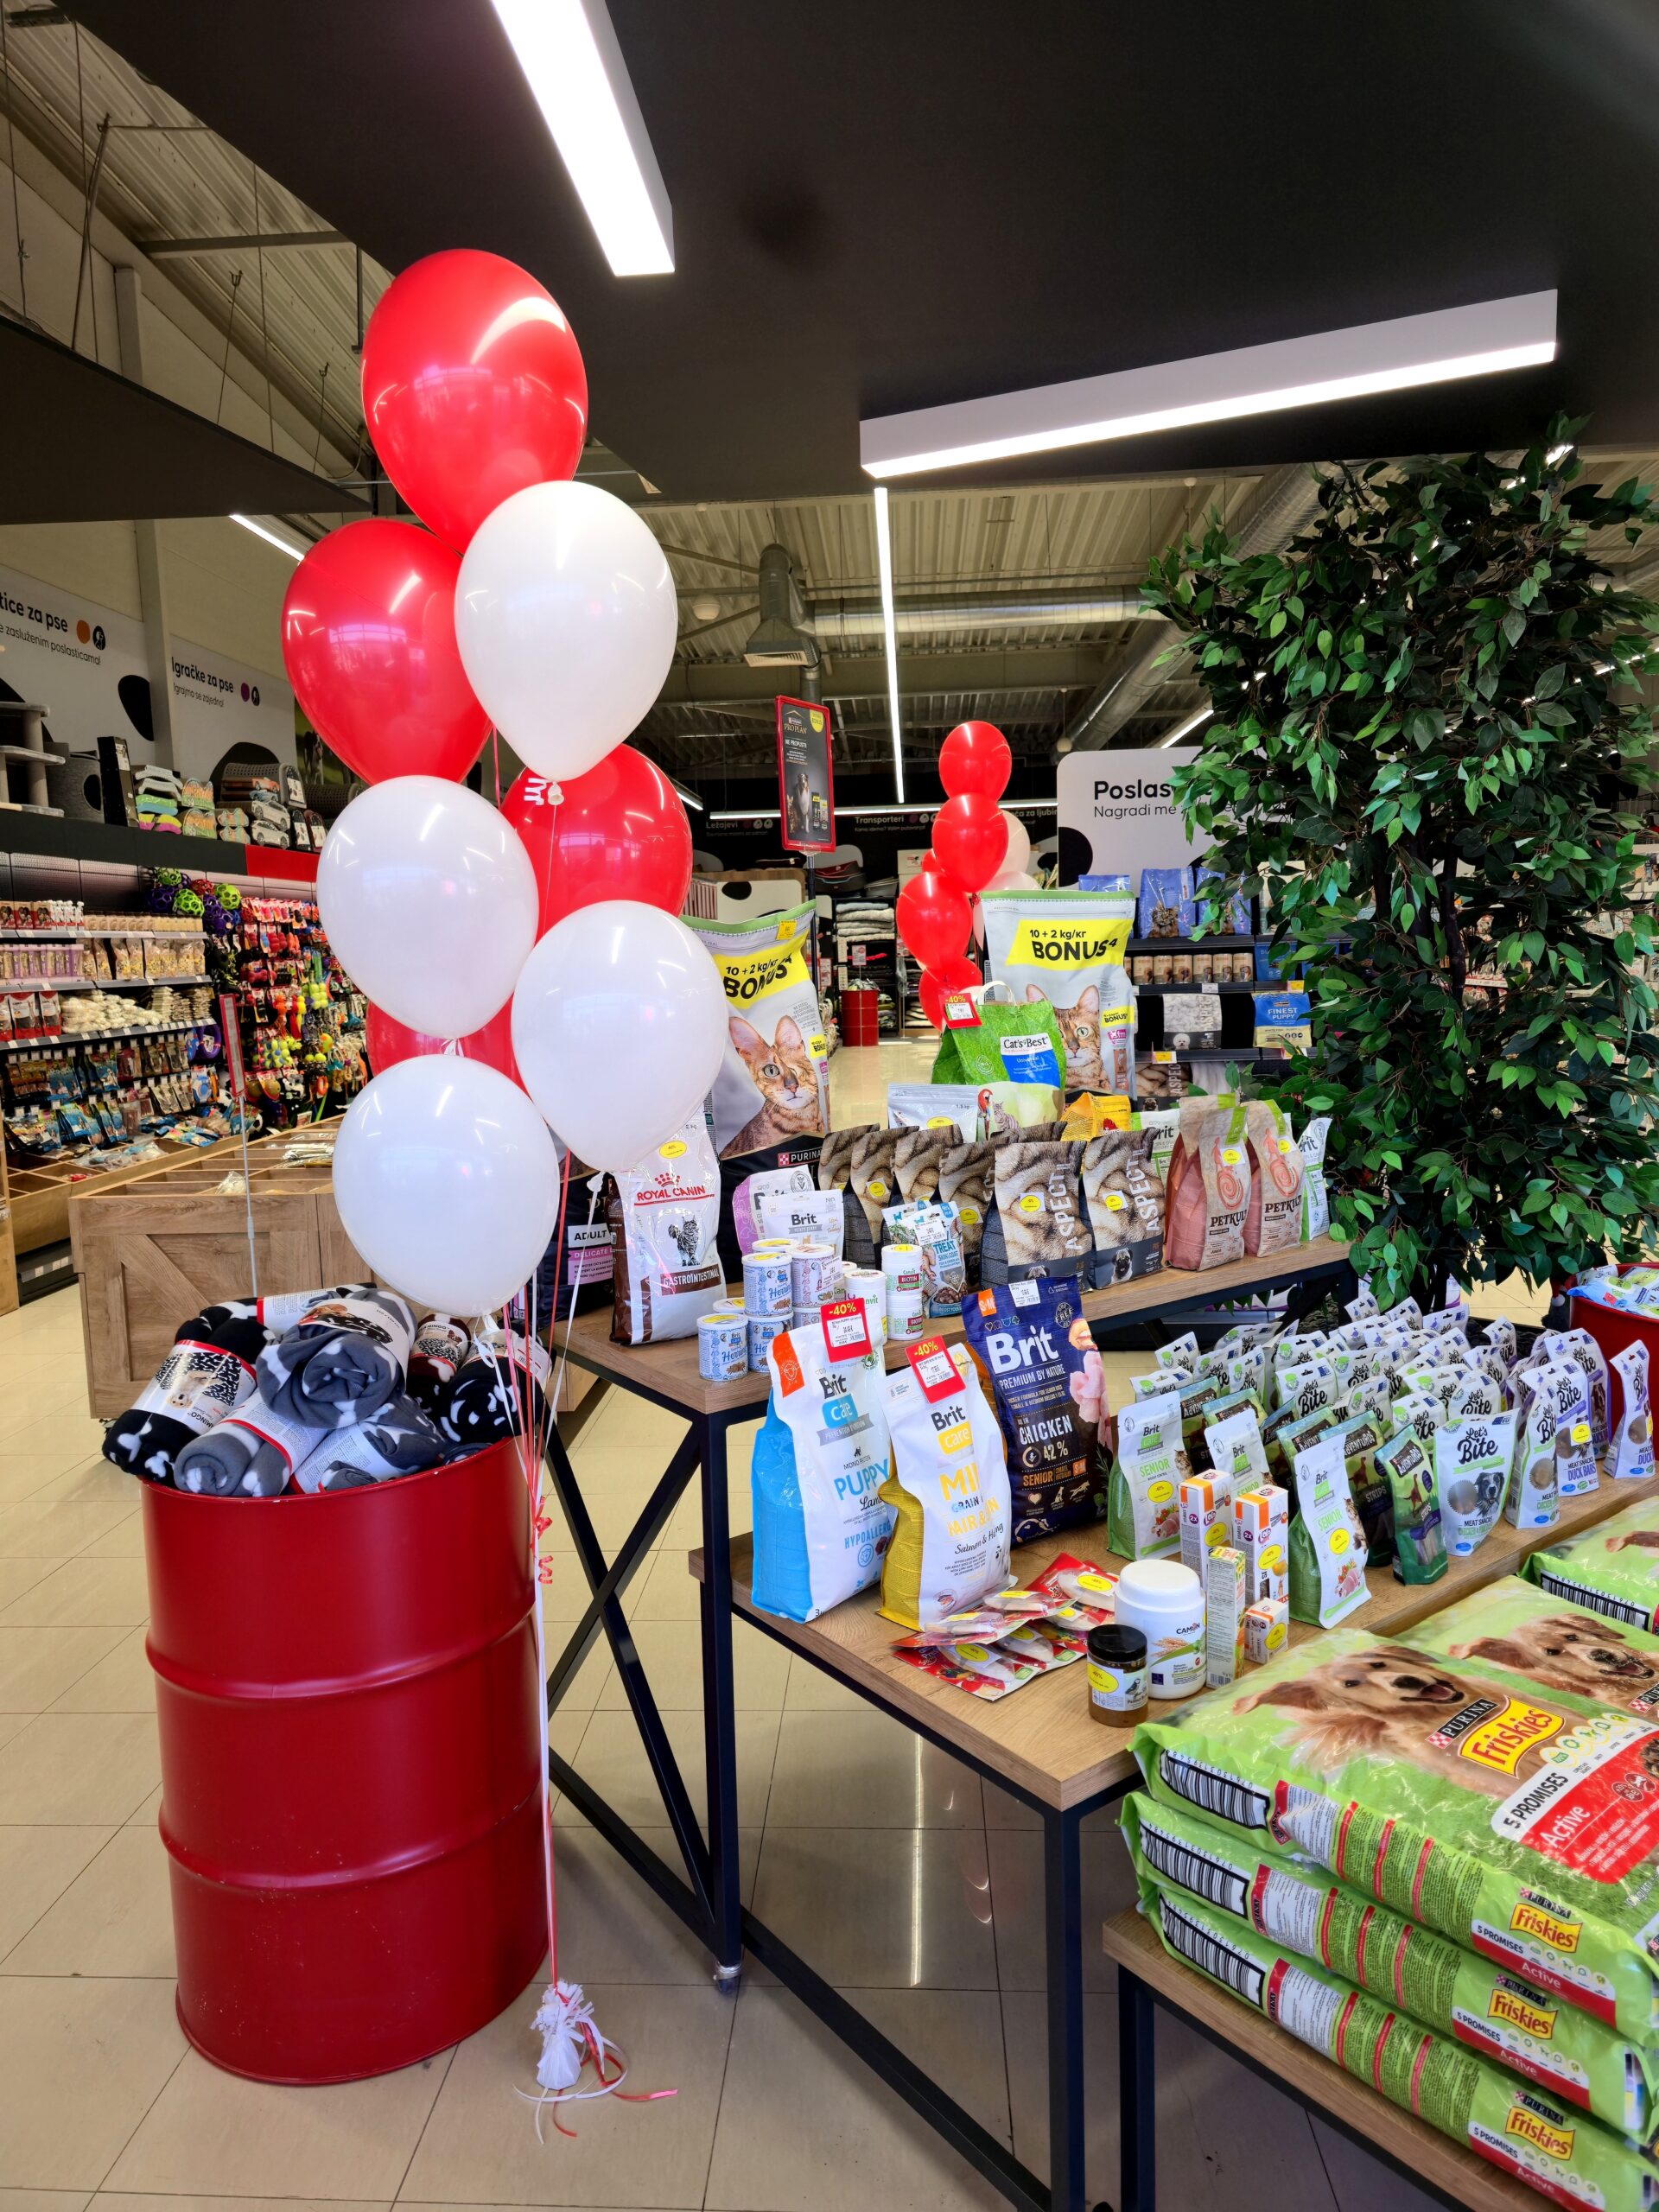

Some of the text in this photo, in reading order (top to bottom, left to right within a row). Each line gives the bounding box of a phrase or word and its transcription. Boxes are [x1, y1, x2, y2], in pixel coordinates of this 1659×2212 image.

[27, 606, 42, 624] za
[46, 613, 68, 632] pse
[5, 625, 102, 666] zasluženim poslasticama!
[171, 656, 234, 693] Igračke za pse
[1094, 779, 1172, 800] Poslas
[855, 814, 905, 825] Transporteri
[1094, 804, 1177, 820] Nagradi me
[706, 820, 738, 831] Ležajevi
[726, 966, 739, 976] 10
[749, 964, 755, 974] 2
[1004, 1039, 1024, 1049] Cat's
[1027, 1037, 1046, 1047] Best
[1168, 1064, 1183, 1096] ASPEC
[1157, 1126, 1174, 1140] rit
[791, 1150, 822, 1162] PURINA
[637, 1185, 706, 1201] ROYAL CANIN
[791, 1213, 817, 1225] Brit
[574, 1230, 607, 1241] ADULT
[575, 1248, 608, 1259] DELICATE
[933, 1240, 957, 1254] TREAT
[664, 1268, 719, 1286] GASTROINTESTINAL
[830, 1303, 856, 1315] -40%
[866, 1294, 879, 1305] nvit
[1056, 1308, 1074, 1323] FREE
[914, 1341, 938, 1356] -40%
[986, 1325, 1059, 1374] Brit
[1582, 1356, 1596, 1374] ite
[998, 1363, 1066, 1389] PREMIUM BY NATURE
[1556, 1377, 1572, 1390] Let's
[819, 1374, 847, 1399] Brit
[1304, 1380, 1319, 1393] Let's
[1468, 1389, 1484, 1402] Let's
[1298, 1390, 1328, 1416] Bite
[1557, 1386, 1581, 1414] Bite
[931, 1405, 966, 1431] Brit
[944, 1427, 970, 1447] care
[1020, 1414, 1073, 1445] CHICKEN
[1143, 1424, 1160, 1436] Brit
[1415, 1421, 1439, 1440] ite
[1465, 1427, 1488, 1440] Let's
[1537, 1416, 1556, 1443] Bit
[1043, 1440, 1069, 1461] 42 %
[1232, 1445, 1245, 1458] Brit
[1458, 1438, 1498, 1465] Bite
[1140, 1459, 1170, 1478] SENIOR
[1578, 1457, 1593, 1467] SNACKS
[834, 1459, 890, 1500] PUPPY
[1023, 1471, 1053, 1486] SENIOR
[1315, 1471, 1328, 1484] Brit
[1567, 1463, 1596, 1481] DUCK BARS
[859, 1496, 883, 1511] Lam
[1364, 1485, 1387, 1503] STRIPS
[1318, 1509, 1343, 1531] SENIOR
[1478, 1516, 1493, 1526] SNACKS
[844, 1521, 891, 1548] HYPOALLERG
[955, 1536, 988, 1554] Salmon &
[1176, 1623, 1200, 1634] CAMON
[1441, 1700, 1494, 1738] PURINA
[1471, 1709, 1553, 1765] Friskies
[1503, 1772, 1568, 1829] 5 PROMISES
[1540, 1805, 1590, 1847] Active
[1530, 1892, 1570, 1917] PURINA
[1516, 1908, 1576, 1948] Friskies
[1477, 1925, 1523, 1954] 5 PROMISES
[1522, 1962, 1560, 1988] Active
[1506, 1980, 1546, 2005] PURINA
[1493, 1994, 1551, 2034] Friskies
[1457, 2012, 1501, 2042] 5 PROMISES
[1500, 2050, 1537, 2075] Active
[1525, 2098, 1563, 2123] PURINA
[1474, 2126, 1519, 2158] 5 PROMISES
[1511, 2113, 1570, 2155] Friskies
[1517, 2167, 1555, 2192] Active
